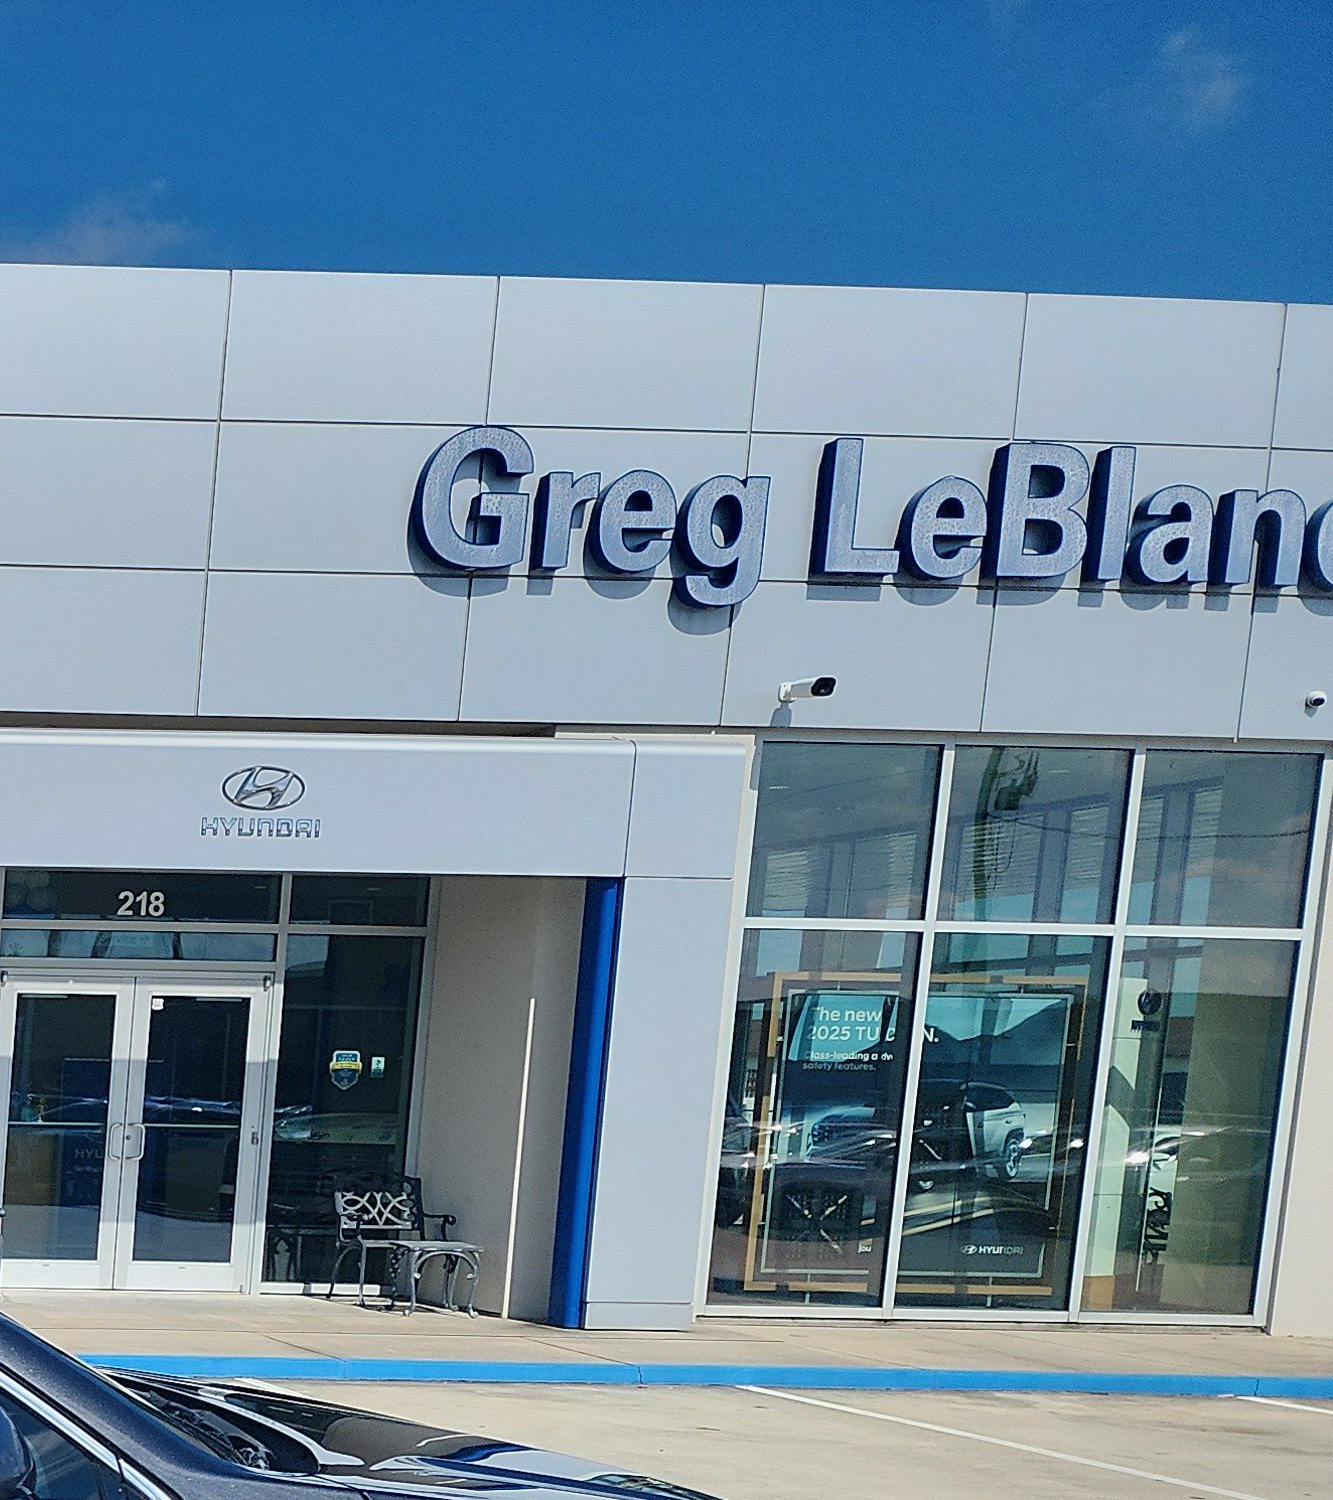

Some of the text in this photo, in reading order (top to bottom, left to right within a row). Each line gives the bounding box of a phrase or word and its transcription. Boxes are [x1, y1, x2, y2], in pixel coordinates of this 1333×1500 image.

[411, 425, 1333, 608] Greg LeBlan
[200, 816, 321, 838] HYUNDAI
[116, 890, 165, 917] 218
[844, 1009, 882, 1022] new
[808, 1025, 851, 1041] 2025
